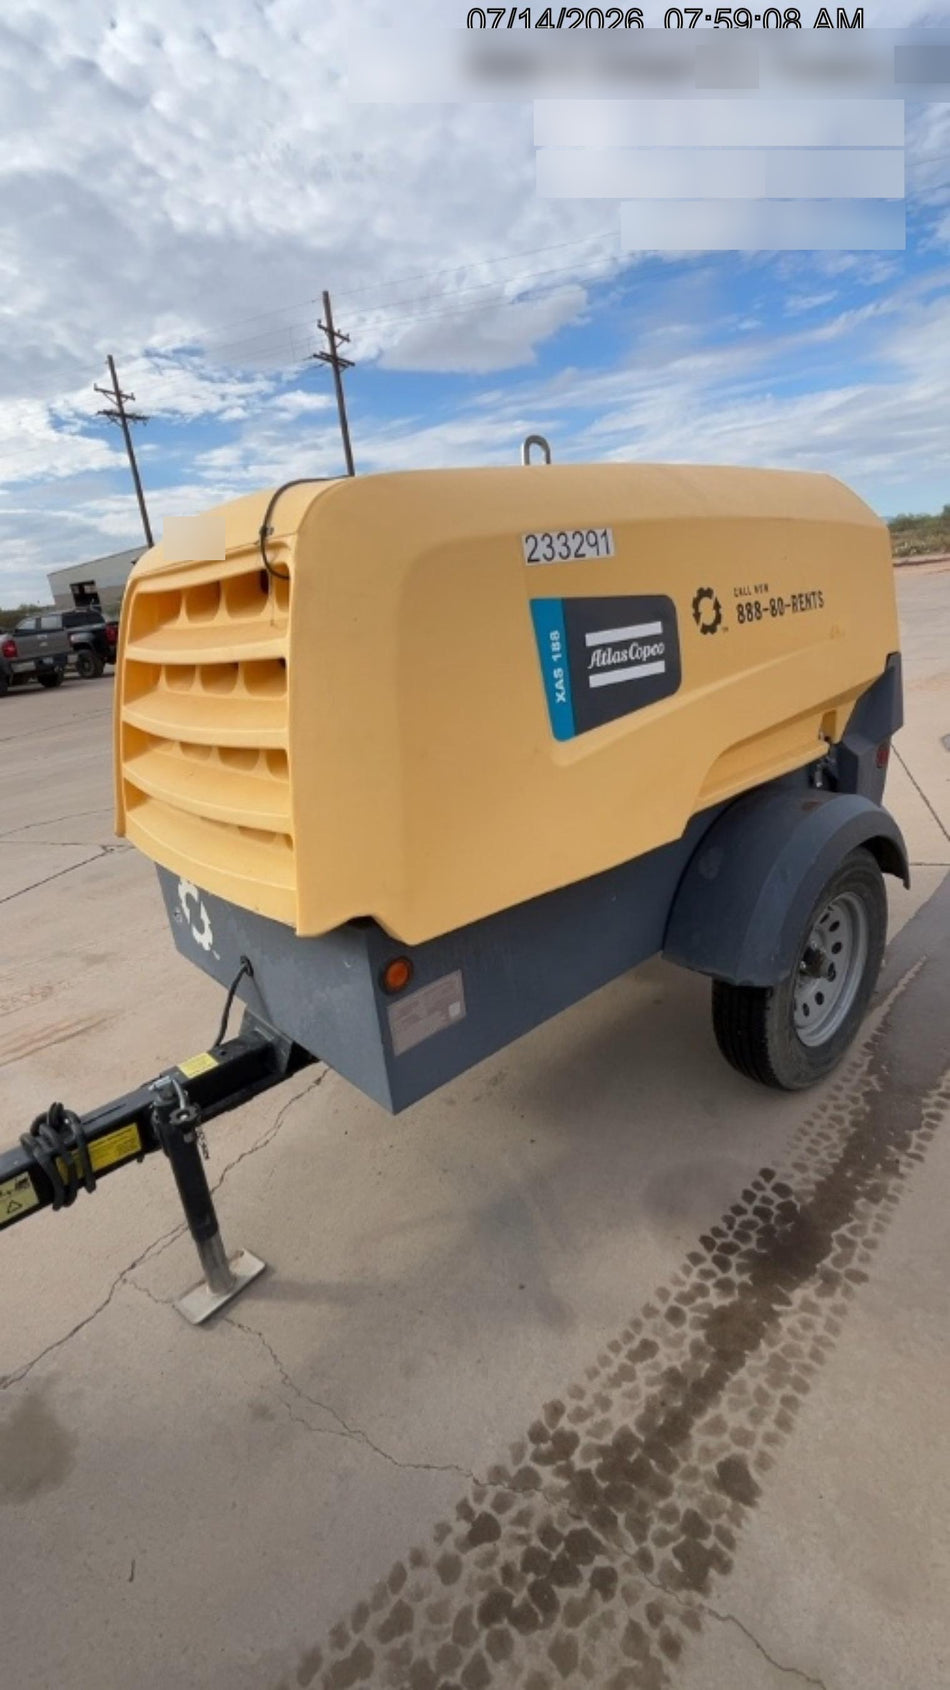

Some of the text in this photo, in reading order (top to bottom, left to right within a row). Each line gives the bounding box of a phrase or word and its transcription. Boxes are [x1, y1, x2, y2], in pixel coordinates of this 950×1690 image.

[525, 528, 610, 563] 233291
[733, 585, 752, 598] CALL
[736, 590, 824, 624] 888-80-RENTS
[549, 630, 567, 703] XAS 188
